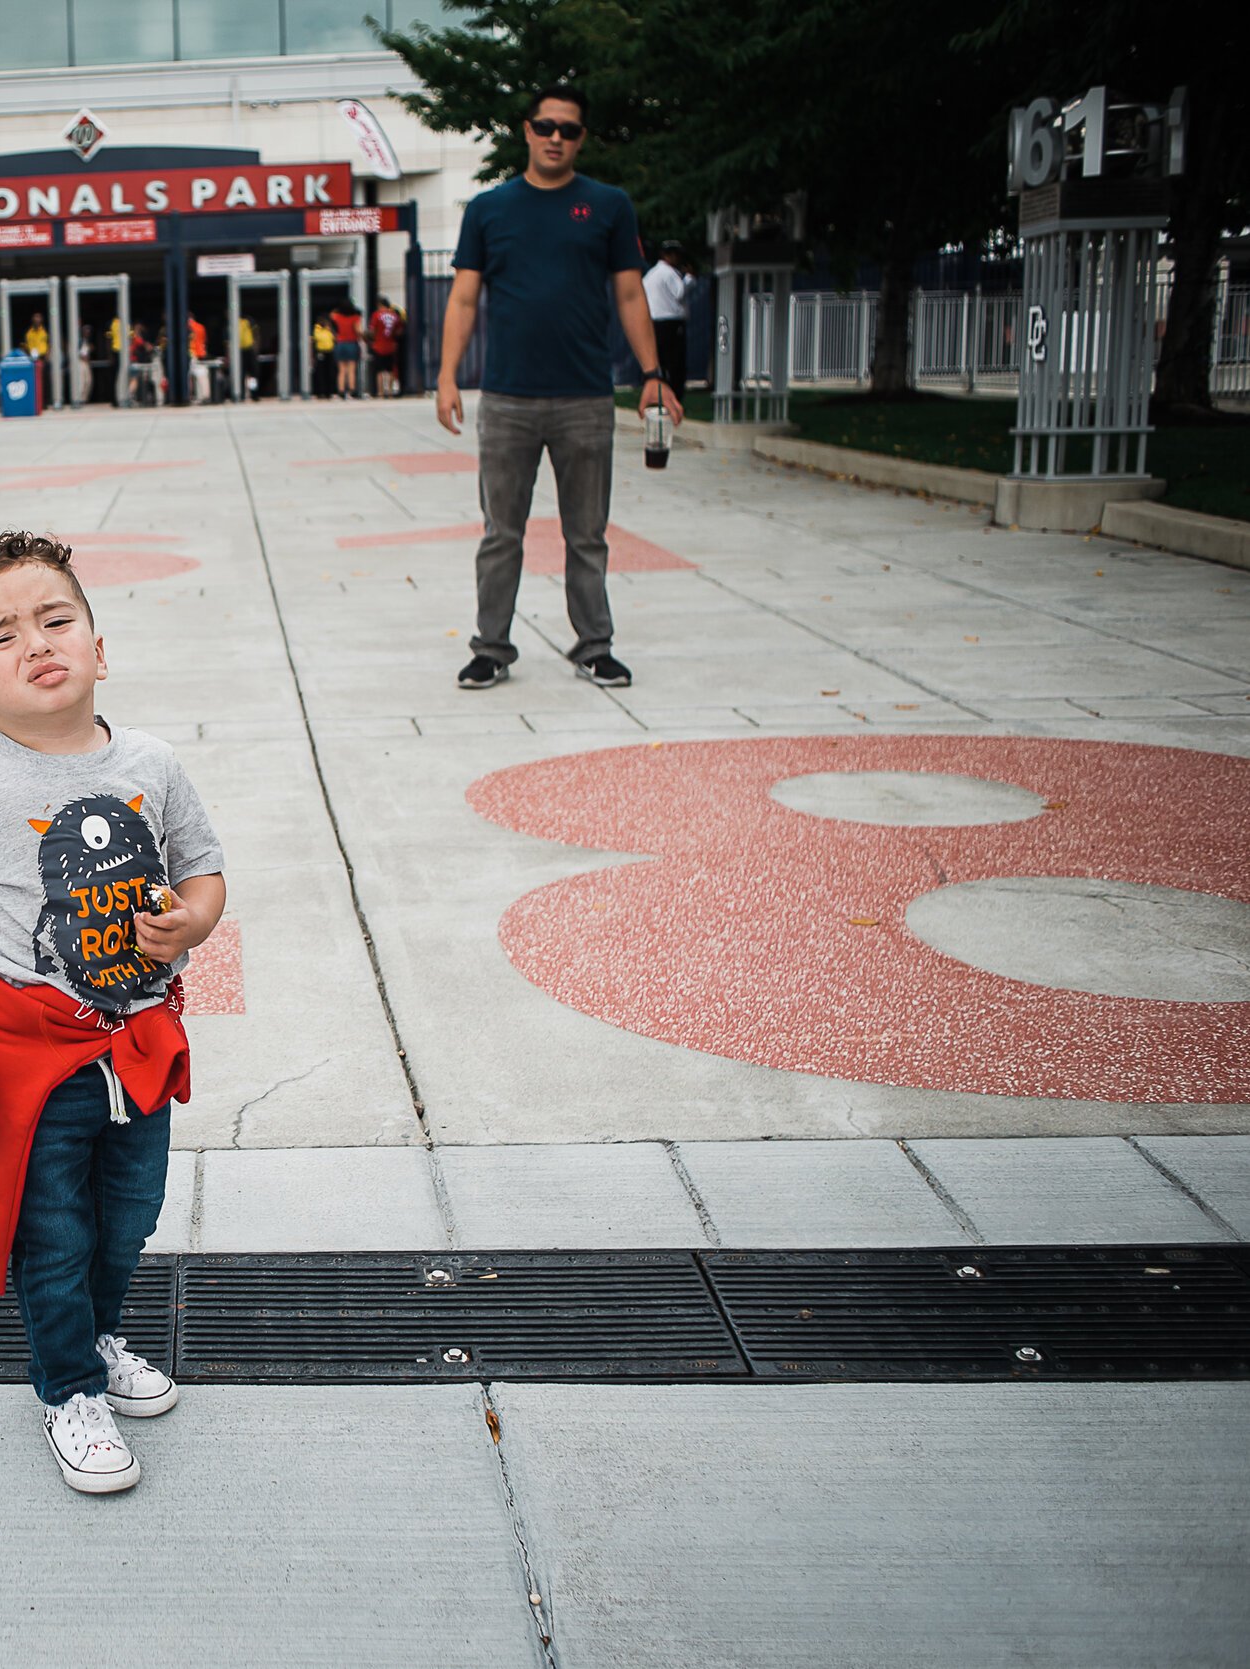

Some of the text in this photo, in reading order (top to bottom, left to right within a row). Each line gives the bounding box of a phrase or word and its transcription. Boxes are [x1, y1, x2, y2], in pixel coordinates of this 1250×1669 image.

[191, 173, 333, 209] PARK
[70, 877, 145, 918] JUST
[81, 921, 130, 961] ROL
[86, 963, 138, 987] WITH
